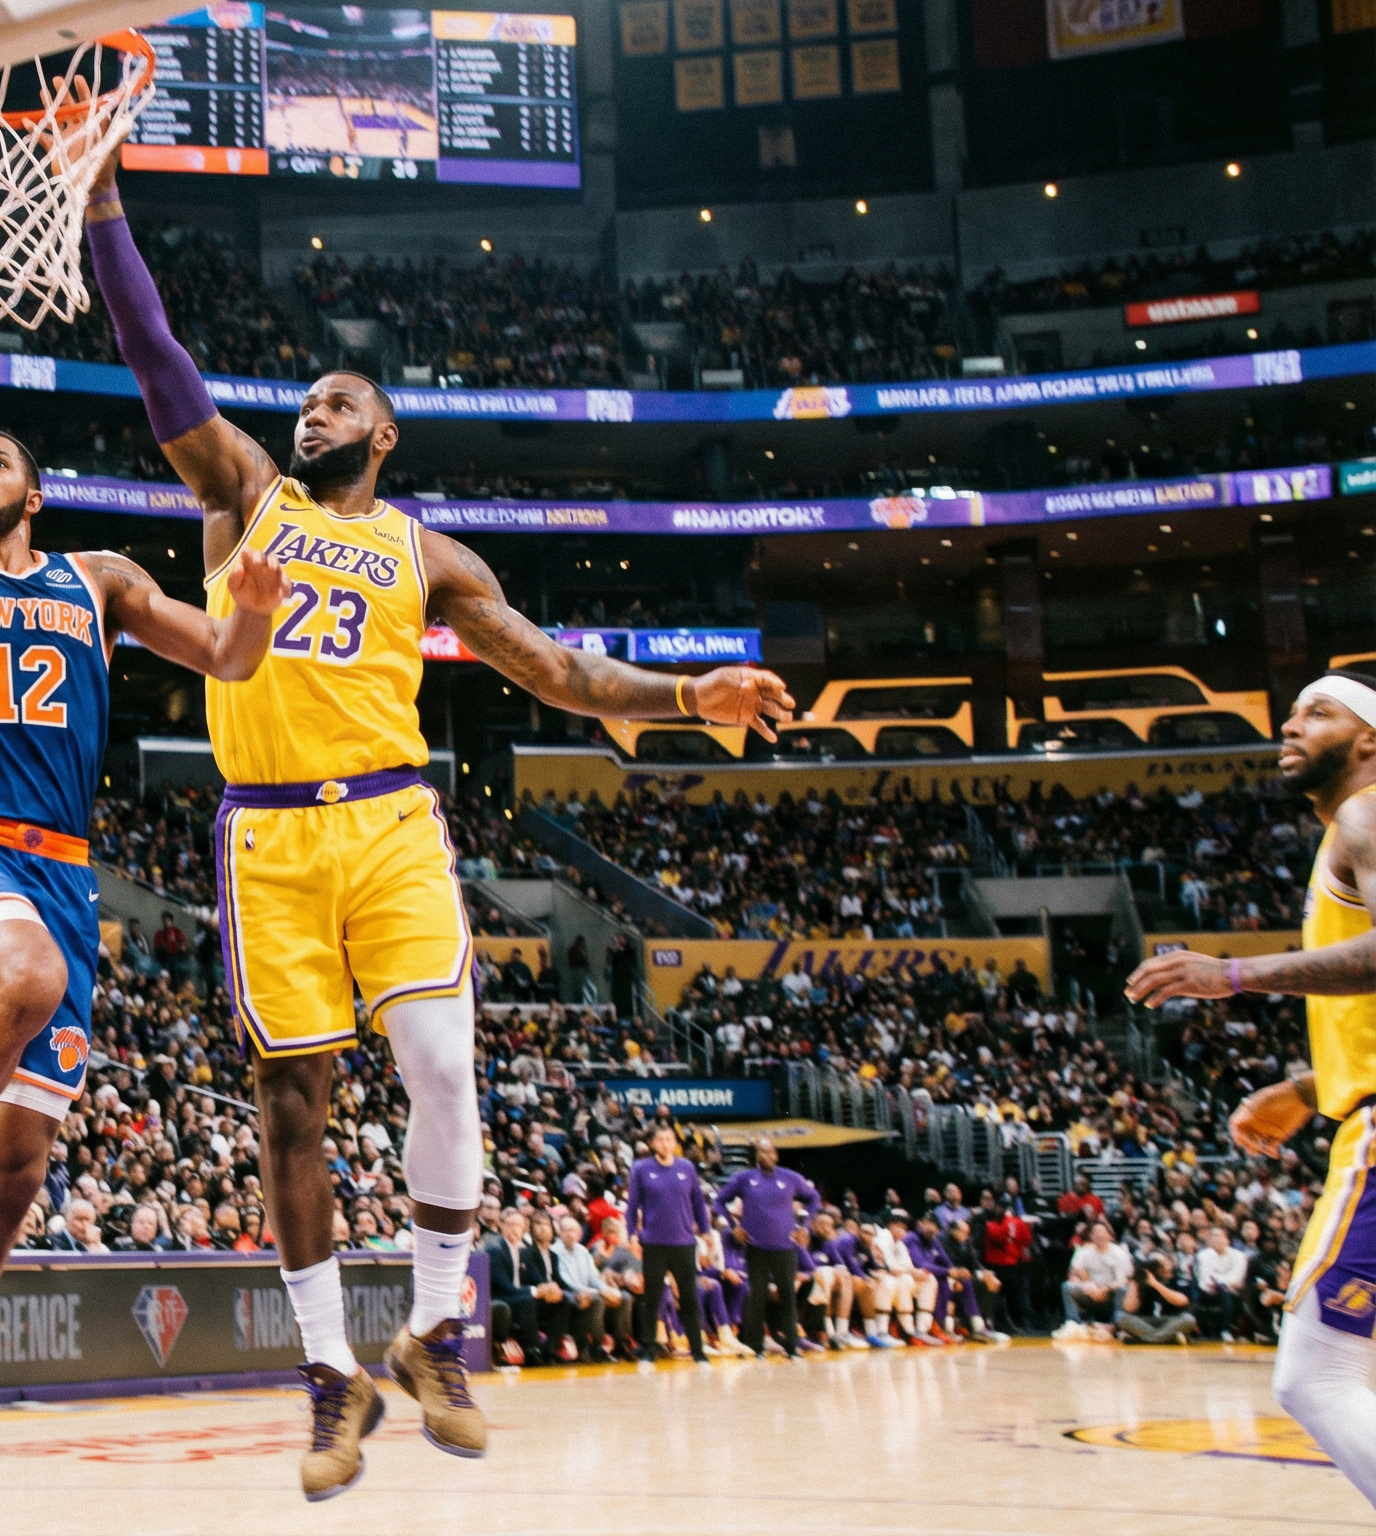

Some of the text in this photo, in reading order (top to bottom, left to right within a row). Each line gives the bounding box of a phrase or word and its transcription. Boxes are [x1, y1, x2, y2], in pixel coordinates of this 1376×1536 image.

[264, 523, 400, 588] LAKERS
[17, 597, 94, 648] YORK
[270, 581, 368, 665] 23
